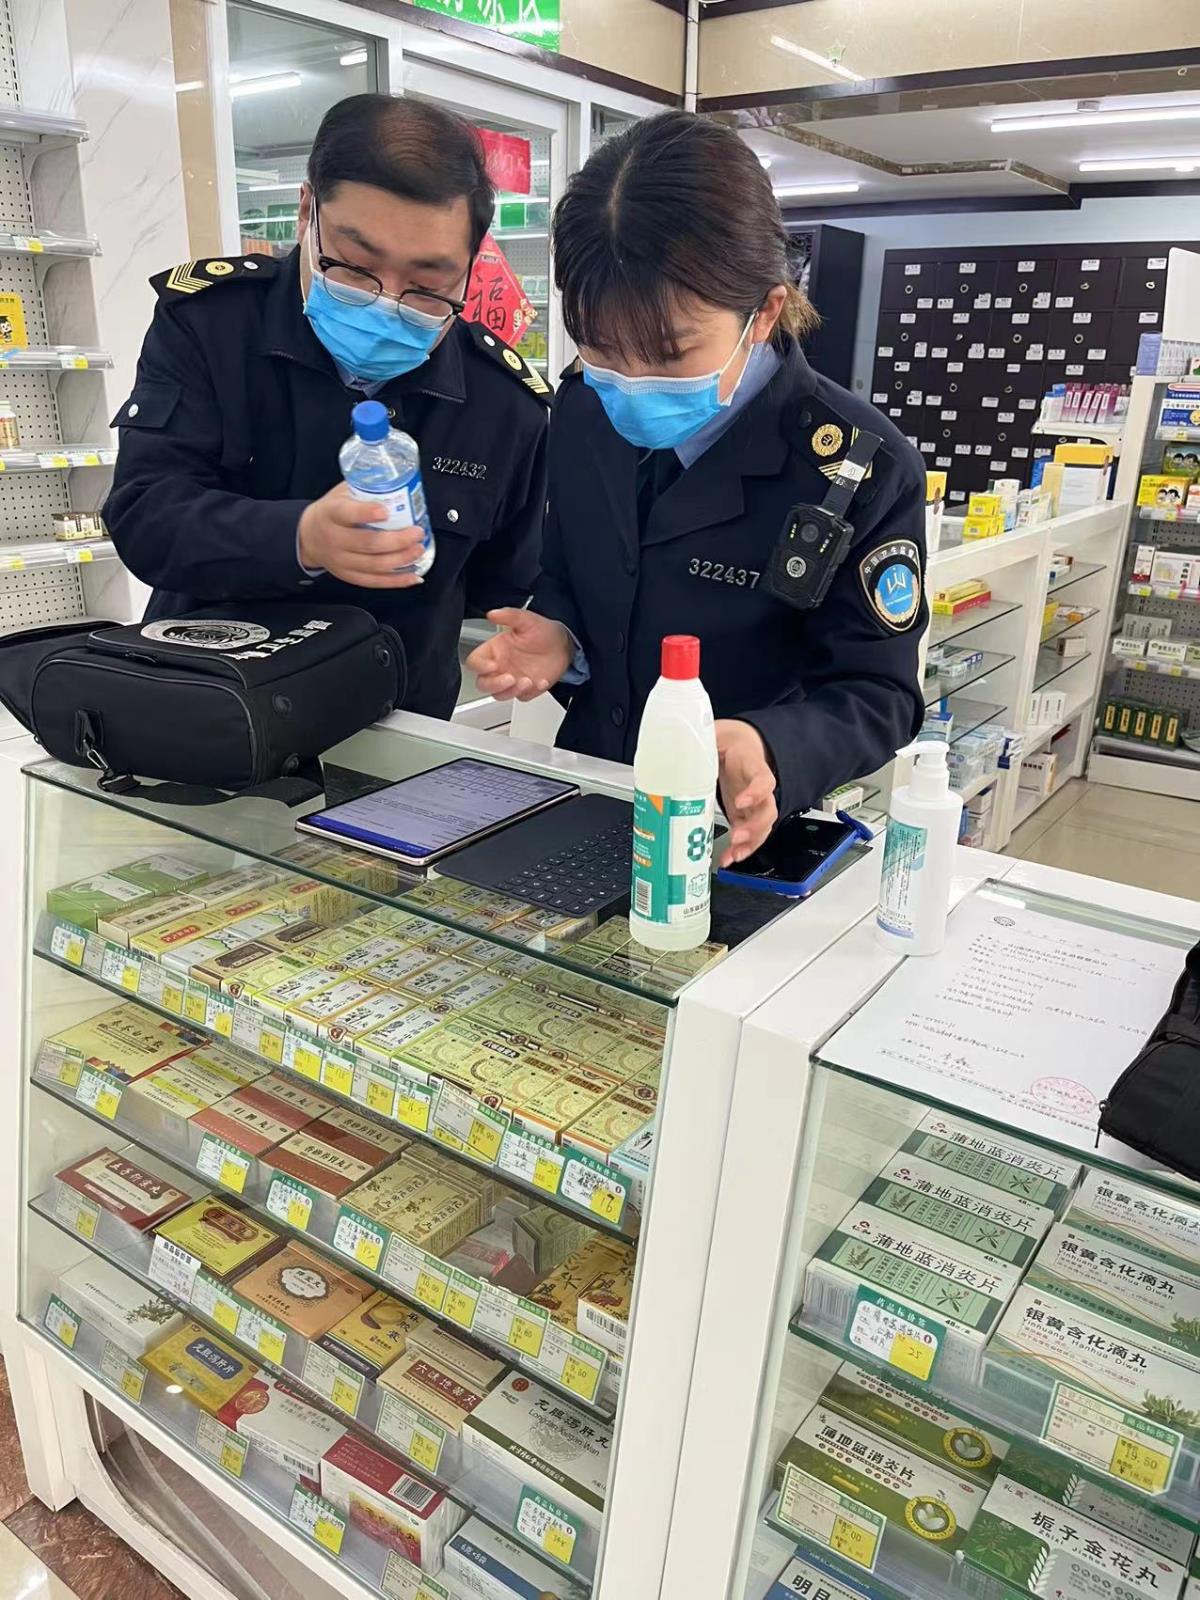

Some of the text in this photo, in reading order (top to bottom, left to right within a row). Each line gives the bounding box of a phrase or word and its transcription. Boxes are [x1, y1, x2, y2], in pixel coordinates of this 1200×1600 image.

[471, 274, 507, 332] 福
[432, 456, 487, 480] 322432
[688, 558, 761, 589] 322437
[950, 1131, 1064, 1181] 蒲地蓝消炎片
[913, 1178, 1033, 1234] 蒲地蓝消炎片
[872, 1231, 1000, 1295] 蒲地蓝消炎片
[1058, 1250, 1174, 1301] Yinhuang Hanhua Diwan
[1060, 1239, 1176, 1295] 银黄含化滴丸
[1022, 1316, 1146, 1375] Yinhuang Hanhua Diwan
[1025, 1306, 1148, 1369] 银黄含化滴丸
[415, 1362, 478, 1407] 六味地黄丸
[528, 1407, 560, 1434] Longdan
[582, 1441, 601, 1458] Wan
[534, 1398, 610, 1450] 龙胆泻肝丸
[1126, 1416, 1176, 1446] 商品标价签
[820, 1424, 916, 1481] 蒲地蓝消炎片
[1124, 1448, 1159, 1471] 19.50
[1031, 1510, 1160, 1590] 栀子金花丸
[1071, 1546, 1108, 1569] Jinhua
[1119, 1571, 1142, 1587] Wan
